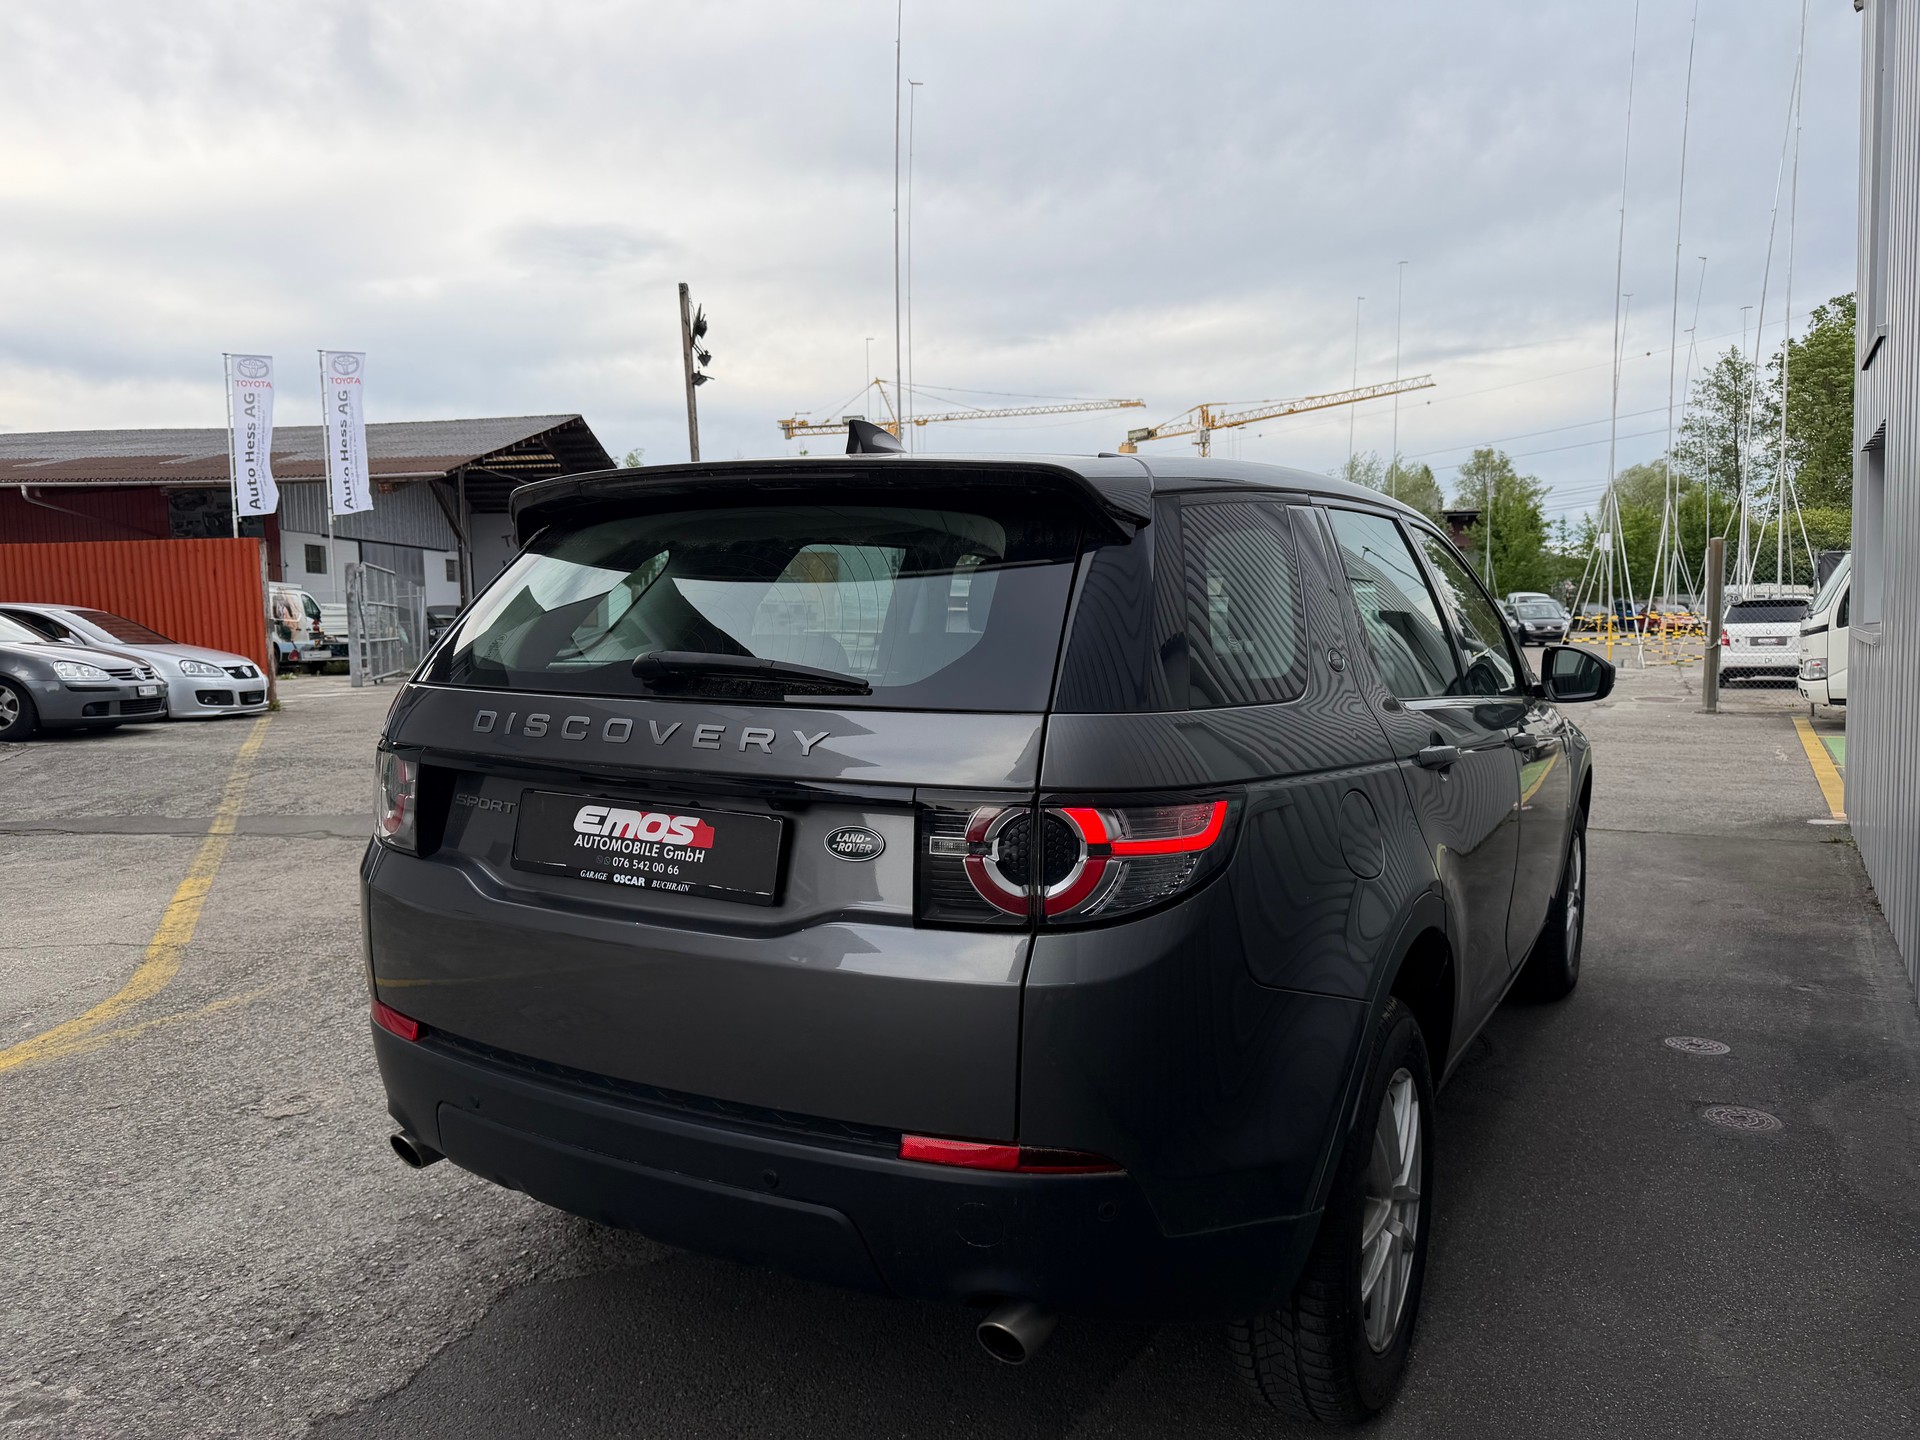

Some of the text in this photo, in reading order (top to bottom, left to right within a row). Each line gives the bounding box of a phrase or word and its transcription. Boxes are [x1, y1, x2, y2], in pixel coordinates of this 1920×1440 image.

[235, 379, 272, 389] TOYOTA
[330, 376, 361, 385] TOYOTA
[243, 392, 261, 510] Auto Hess AG
[337, 389, 353, 510] Auto Hess AG
[472, 709, 831, 757] DISCOVERY
[455, 793, 517, 814] SPORT
[573, 804, 701, 846] EMOS
[836, 832, 865, 842] LAND
[837, 842, 873, 853] ROVER
[573, 834, 706, 863] AUTOMOBILE GmbH
[612, 856, 680, 875] 076 542 00 66
[580, 869, 690, 892] GARAGE OSCAR BUCHRAIN
